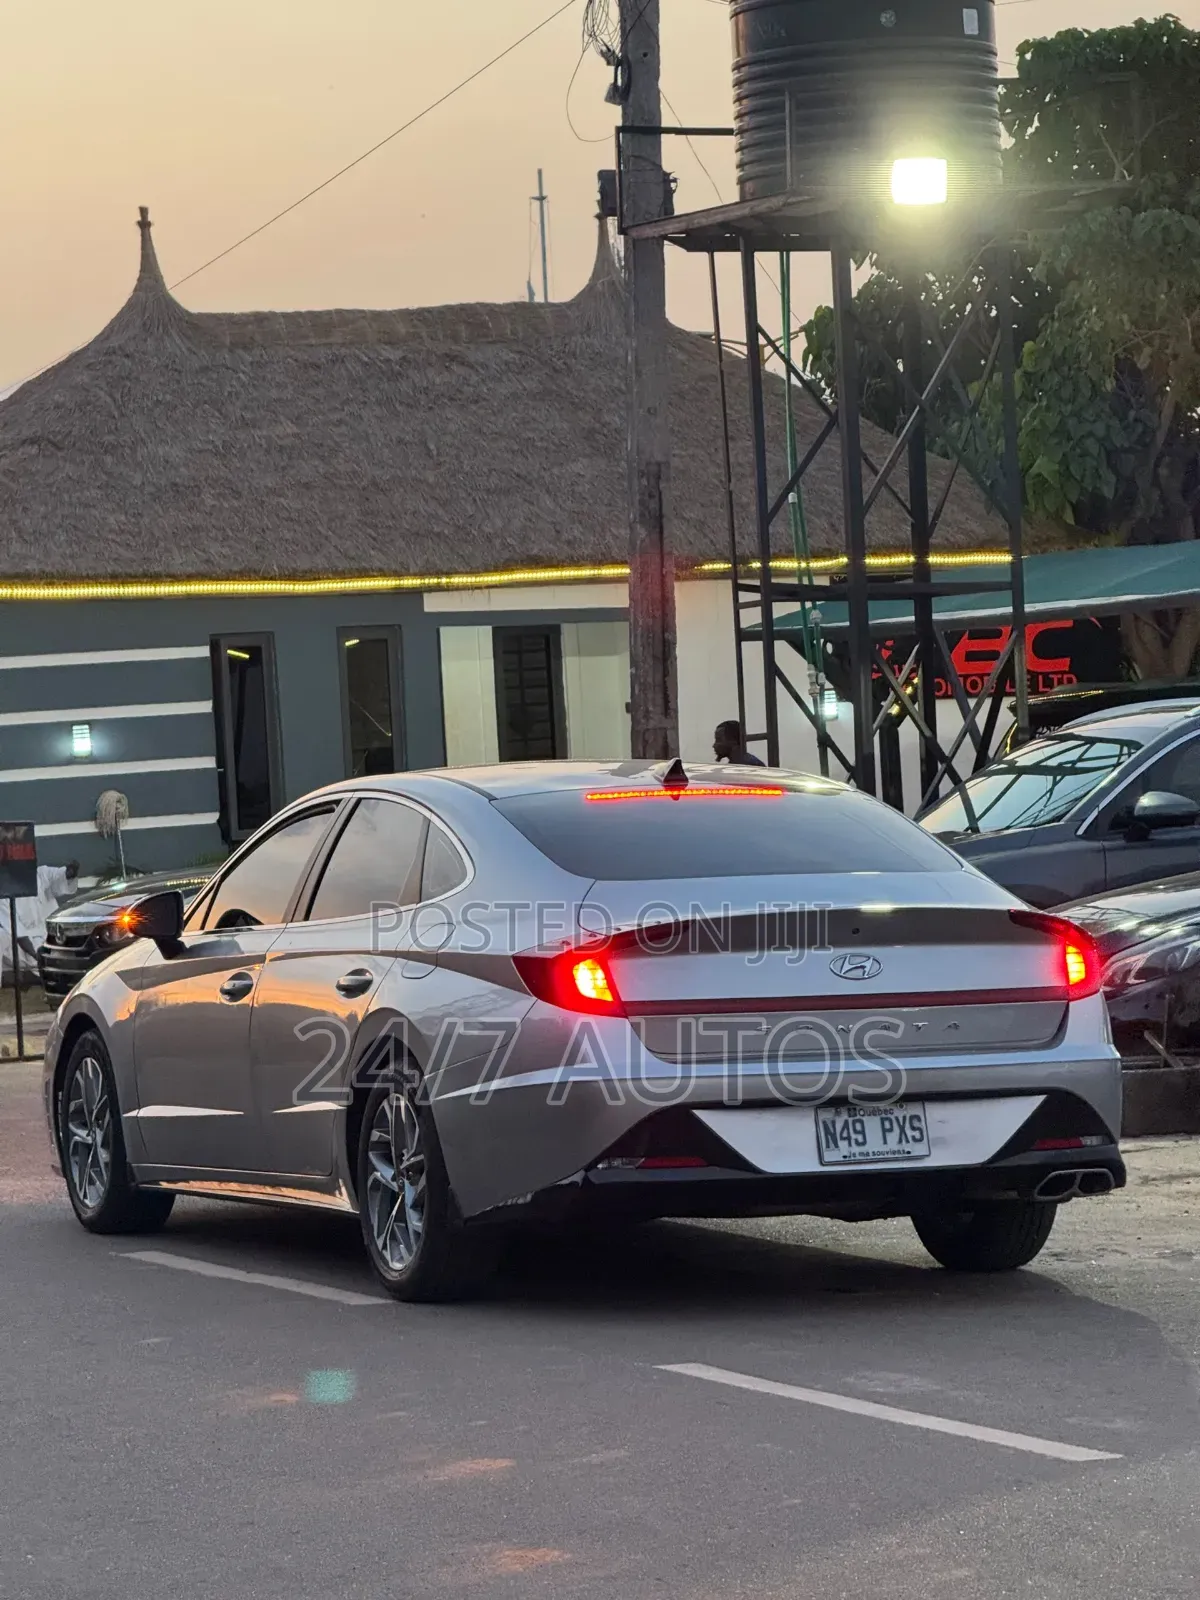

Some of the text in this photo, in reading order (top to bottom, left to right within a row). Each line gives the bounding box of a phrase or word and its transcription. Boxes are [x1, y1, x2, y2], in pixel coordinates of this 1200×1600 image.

[858, 1106, 895, 1117] Québec
[822, 1114, 925, 1149] N49 PXS
